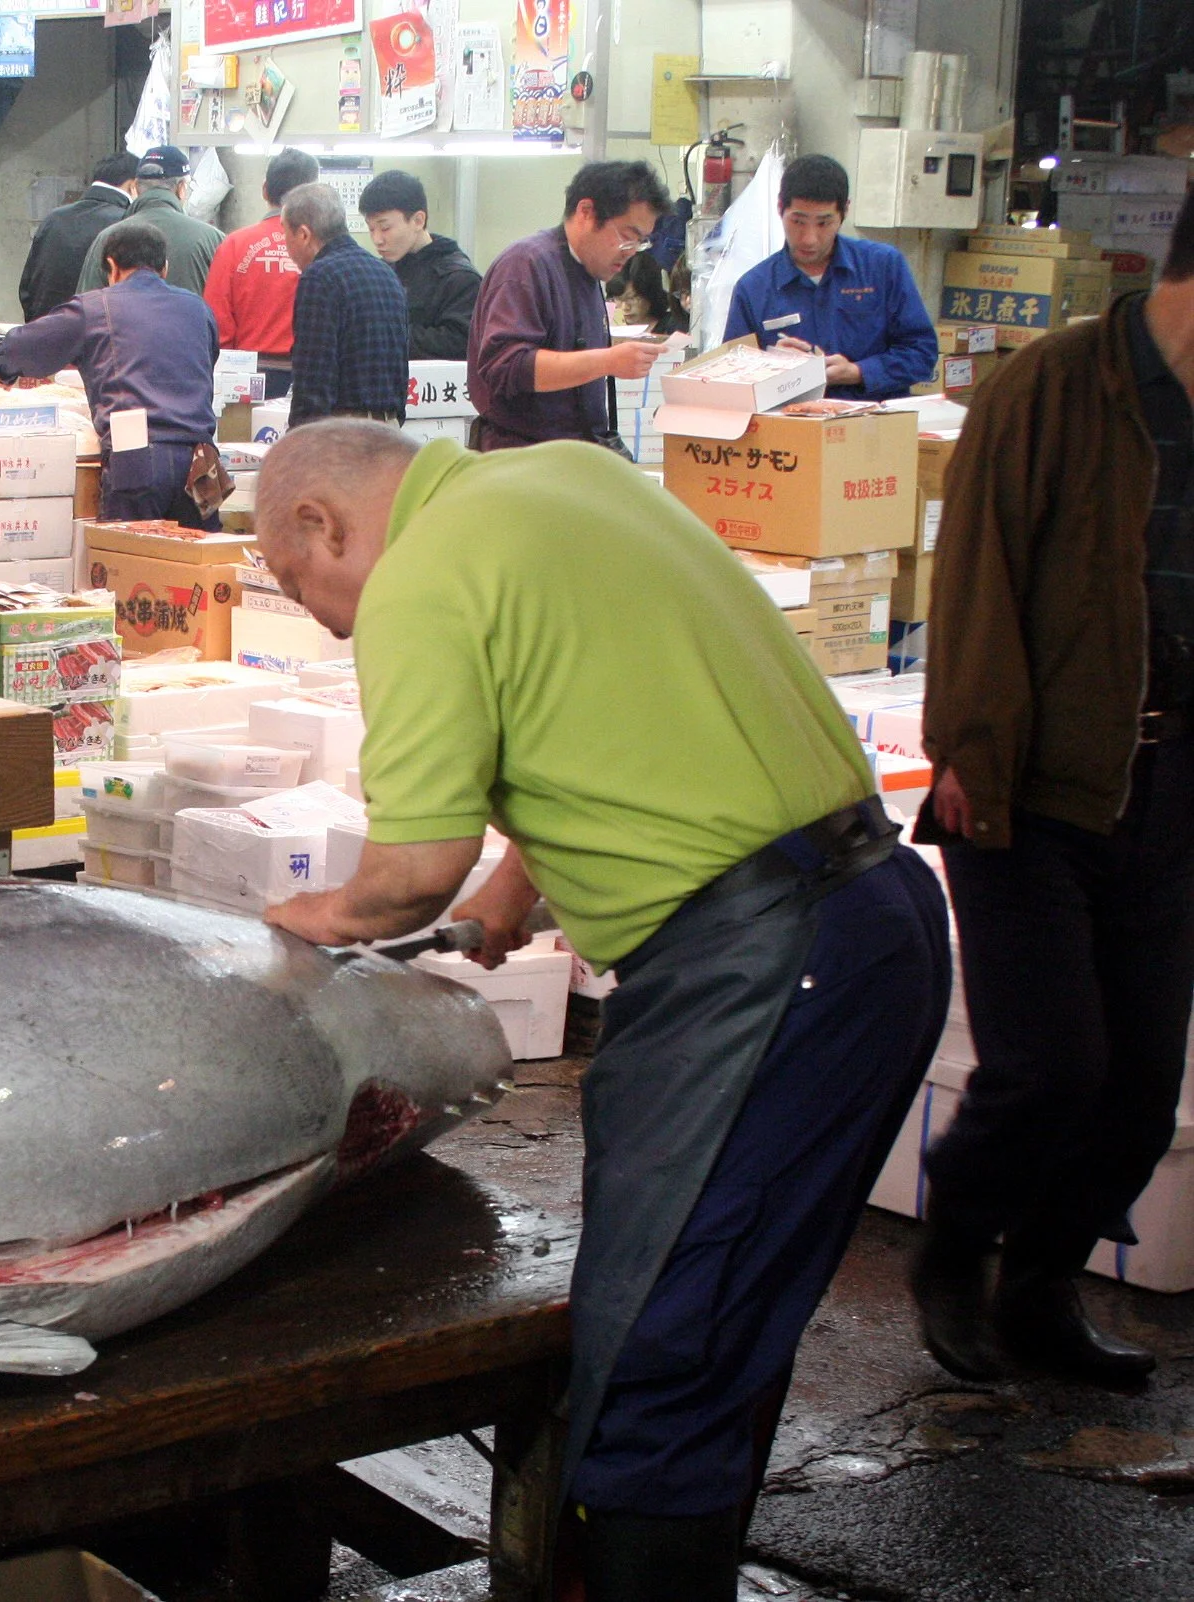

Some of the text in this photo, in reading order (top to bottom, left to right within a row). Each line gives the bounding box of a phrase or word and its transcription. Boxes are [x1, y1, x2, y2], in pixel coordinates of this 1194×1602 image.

[950, 291, 1040, 326] 氷見煮干
[706, 476, 774, 501] スライス
[843, 476, 898, 501] 取扱注意
